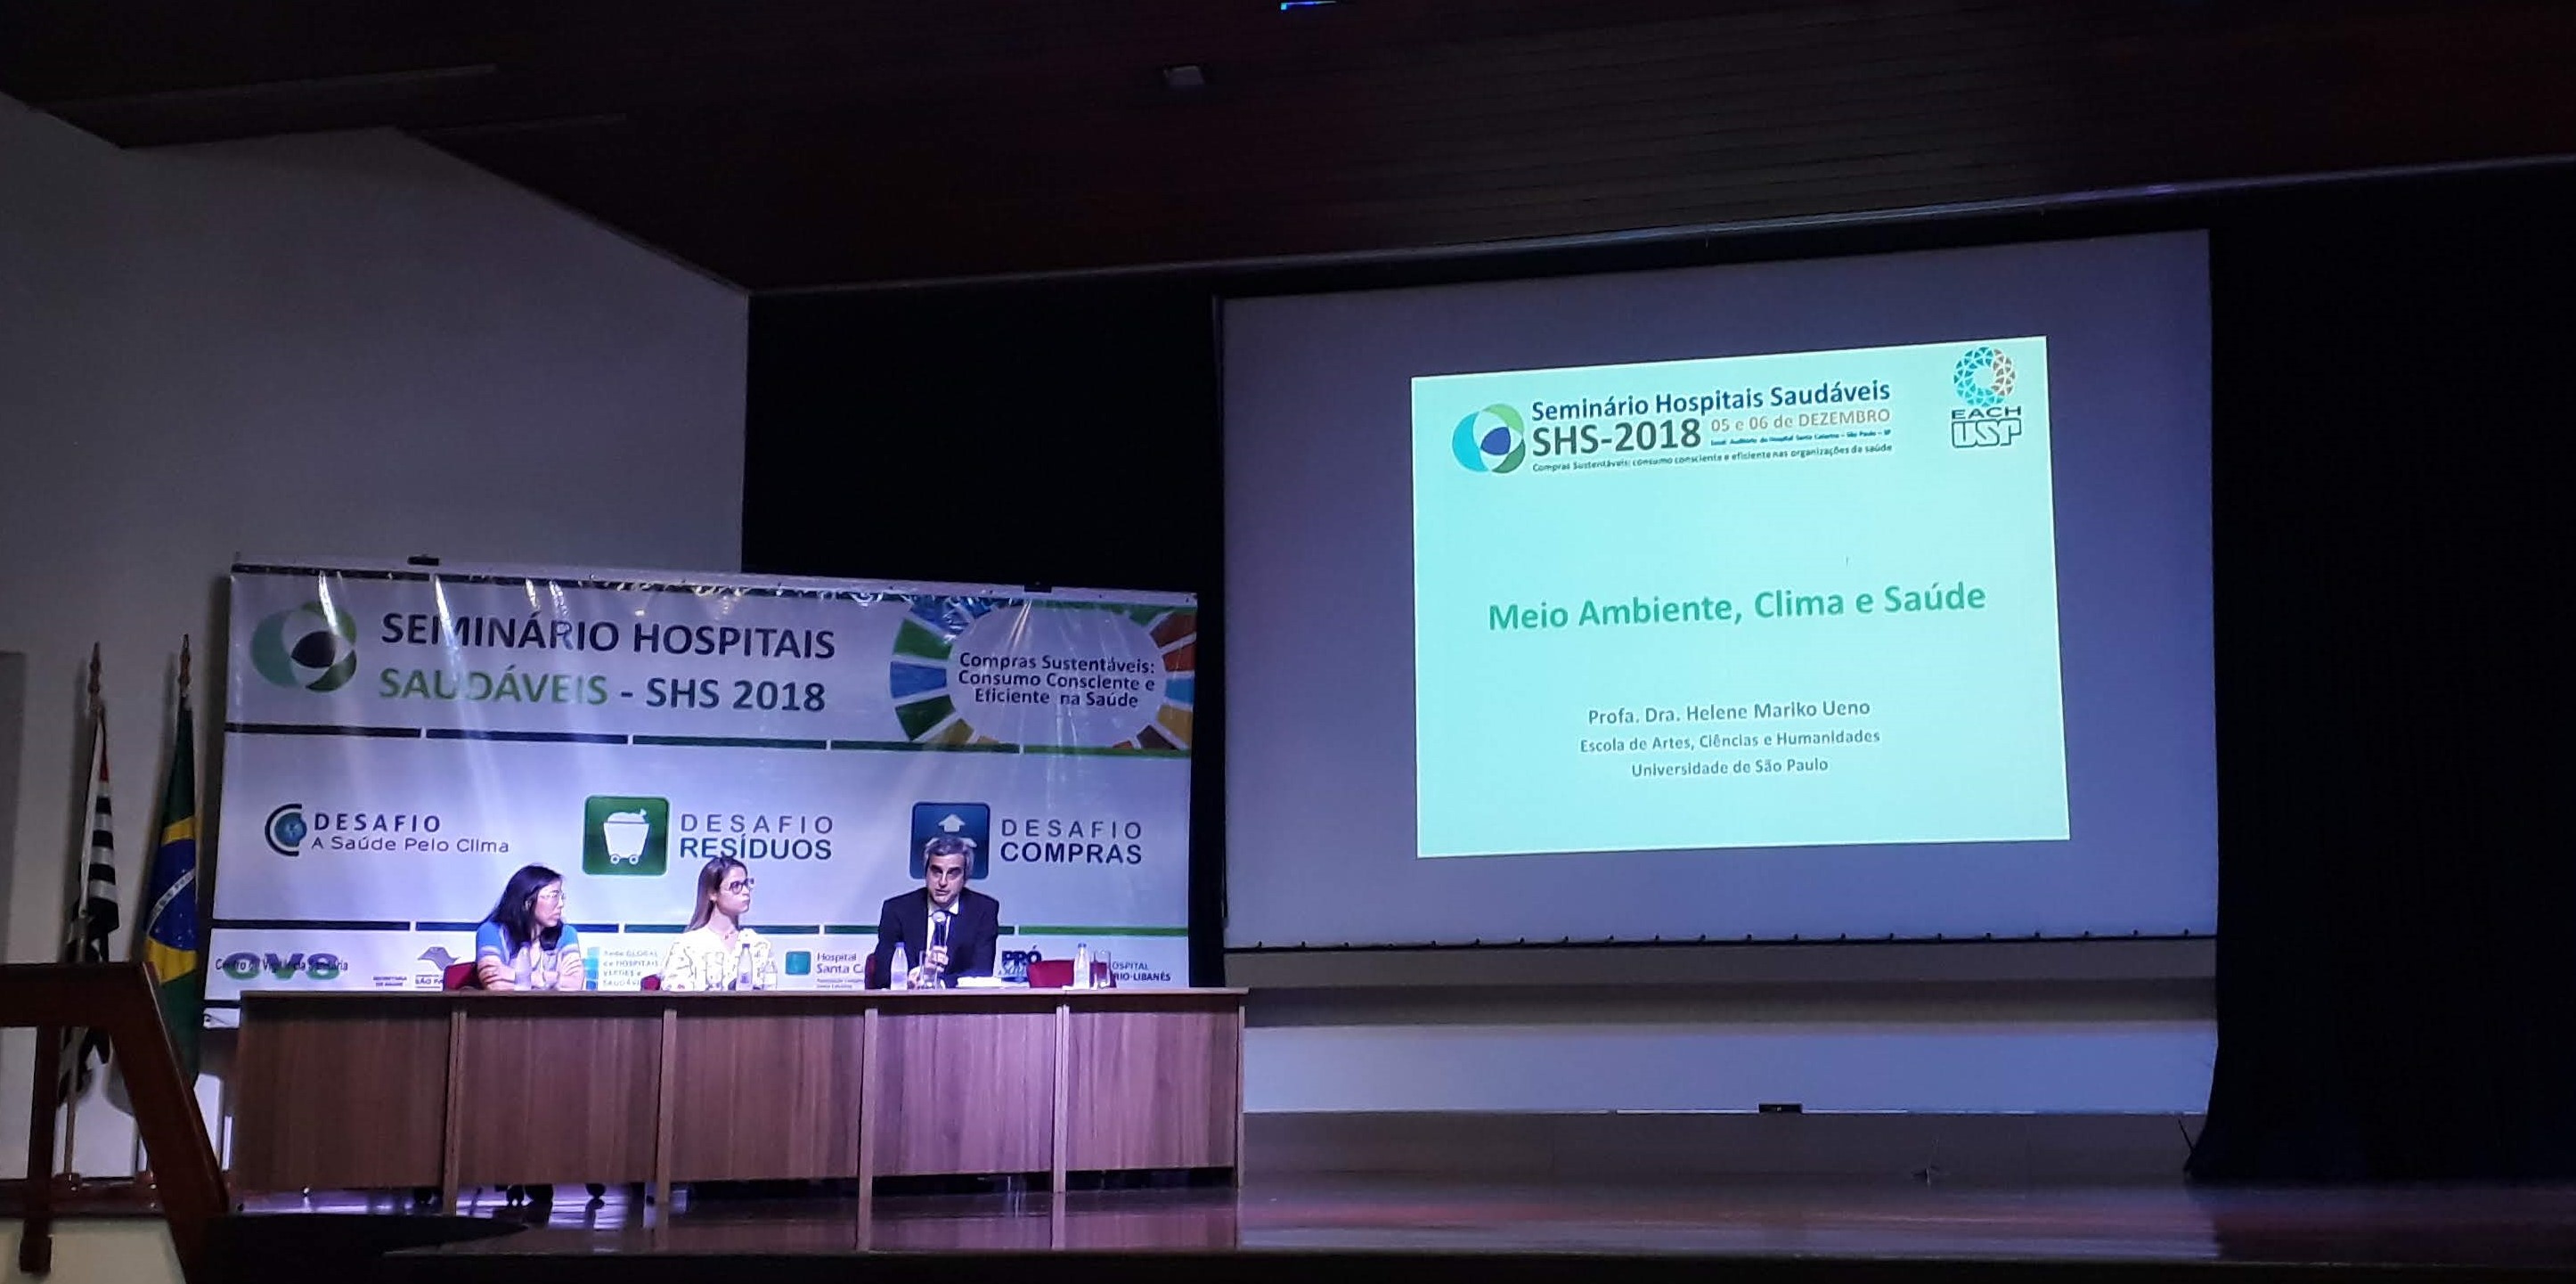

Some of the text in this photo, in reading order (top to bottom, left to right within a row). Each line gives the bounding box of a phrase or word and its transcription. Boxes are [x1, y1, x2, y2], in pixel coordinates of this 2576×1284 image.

[1531, 379, 1892, 421] Seminário Hospitais Saudáveis
[1711, 407, 1892, 433] 05 e 06 de DEZEMBRO
[1952, 406, 2022, 421] EACH
[1532, 417, 1702, 458] SHS-2018
[1952, 418, 2022, 448] USP
[1533, 462, 1570, 472] Compras
[1633, 457, 1673, 467] consumo
[1675, 453, 1722, 465] consciente
[1732, 449, 1771, 461] eficiente
[1790, 445, 1849, 460] organizações
[1865, 442, 1893, 453] saúde
[1488, 581, 1986, 631] Meio Ambiente, Clima e Saúde
[381, 611, 836, 659] SEMINÁRIO HOSPITAIS
[959, 651, 1156, 675] Compras Sustentáveis:
[379, 664, 608, 705] SAUDÁVEIS
[646, 676, 720, 709] SHS
[733, 679, 827, 712] 2018
[958, 669, 1156, 691] Consumo Consciente e
[974, 688, 1138, 709] Eficiente na Saúde
[1588, 699, 1871, 726] Profa. Dra. Helene Mariko Ueno
[1580, 728, 1880, 754] Escola de Artes, Ciências e Humanidades
[1632, 756, 1829, 778] Universidade de São Paulo
[314, 812, 442, 833] DESAFIO
[681, 812, 834, 835] DESAFIO
[1001, 818, 1143, 840] DESAFIO
[312, 833, 510, 855] A Saúde Pelo Clima
[680, 833, 833, 861] RESÍDUOS
[1000, 841, 1143, 866] COMPRAS
[817, 952, 857, 963] Hospital
[817, 962, 850, 974] Santa
[1113, 961, 1148, 970] OSPITAL
[1113, 971, 1171, 982] RIO-LIBANÊS
